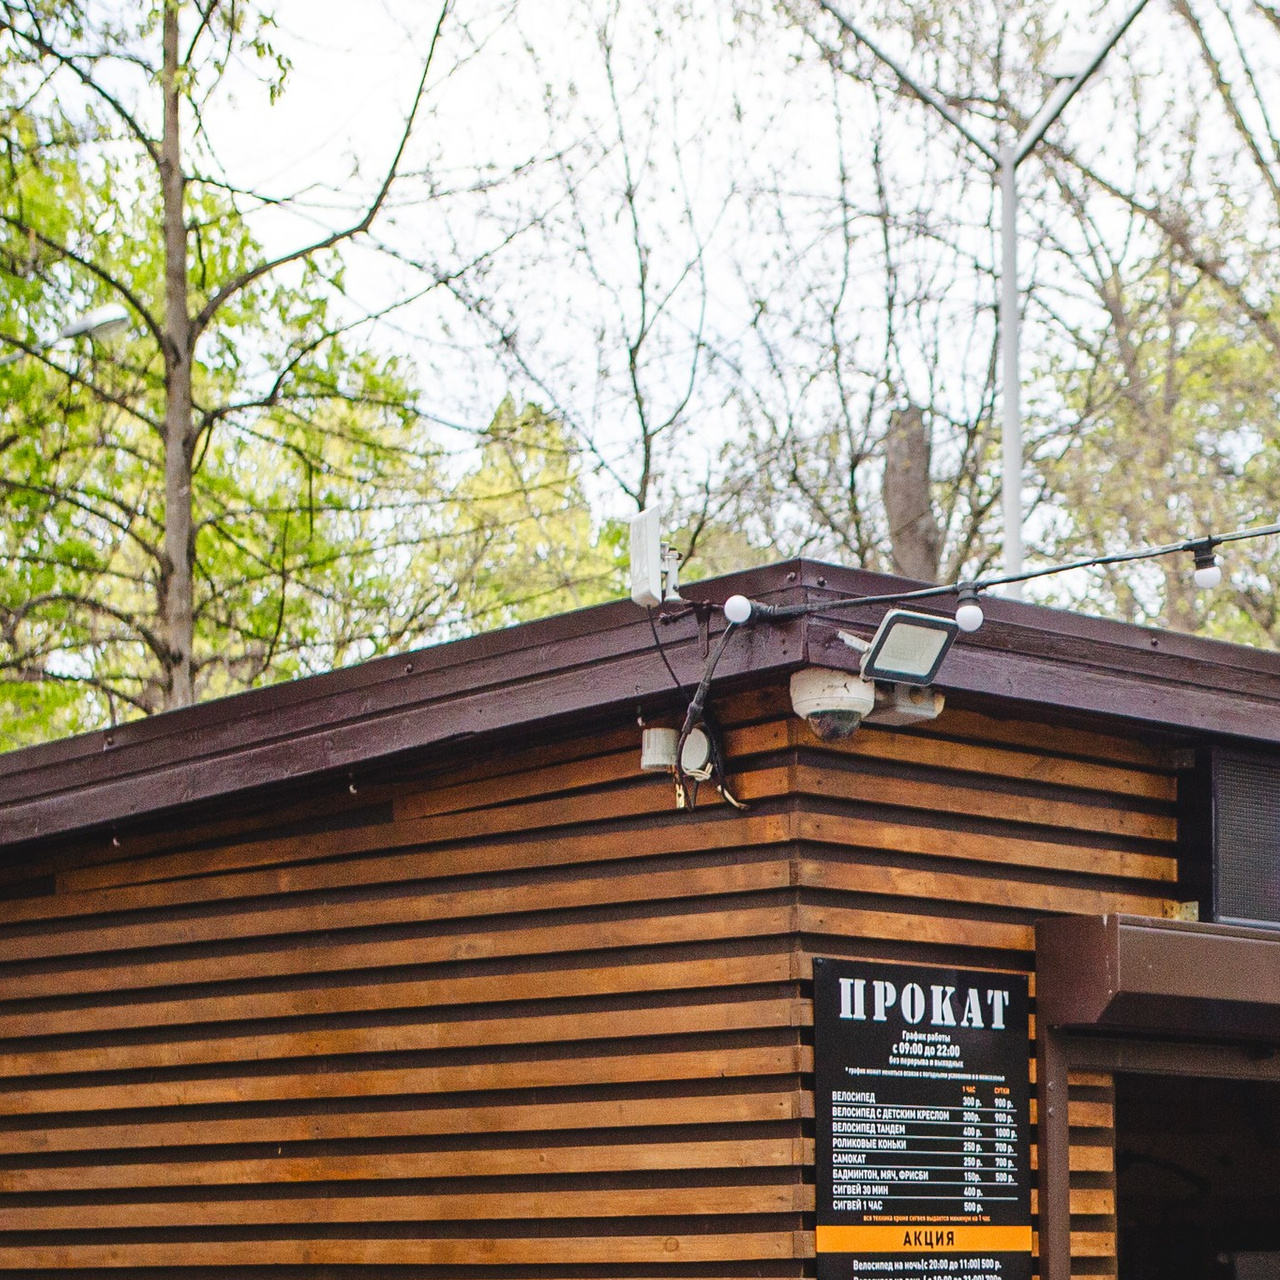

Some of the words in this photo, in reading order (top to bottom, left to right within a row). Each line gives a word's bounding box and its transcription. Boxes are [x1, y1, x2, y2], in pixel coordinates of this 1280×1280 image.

[839, 977, 1009, 1029] ПРОКАТ
[902, 1030, 926, 1042] График
[927, 1032, 951, 1043] работы
[892, 1044, 898, 1054] с
[899, 1042, 923, 1055] 09:00
[924, 1046, 935, 1057] до
[937, 1044, 960, 1058] 22:00
[889, 1055, 900, 1065] без
[900, 1057, 929, 1067] перерыва
[832, 1091, 876, 1104] ВЕЛОСИПЕД
[963, 1096, 975, 1107] 300
[995, 1098, 1006, 1108] 900
[832, 1107, 876, 1119] ВЕЛОСИПЕД
[877, 1108, 882, 1118] С
[883, 1109, 916, 1120] ДЕТСКИМ
[917, 1110, 950, 1121] КРЕСЛОМ
[995, 1113, 1006, 1122] 900
[832, 1122, 876, 1135] ВЕЛОСИПЕД
[877, 1124, 906, 1135] ТАНДЕМ
[963, 1127, 975, 1136] 400
[995, 1128, 1010, 1137] 1000
[833, 1138, 877, 1149] РОЛИКОВЫЕ
[878, 1140, 907, 1150] КОНЬКИ
[963, 1142, 976, 1152] 250
[995, 1143, 1007, 1152] 700
[833, 1154, 866, 1164] САМОКАТ
[964, 1157, 976, 1167] 250
[995, 1158, 1007, 1167] 700
[833, 1169, 880, 1181] БАДМИНТОН,
[880, 1170, 898, 1181] МЯЧ,
[899, 1171, 929, 1181] ФРИСБИ
[995, 1173, 1008, 1182] 500
[833, 1184, 862, 1195] СИГВЕЙ
[863, 1185, 871, 1195] 30
[872, 1186, 889, 1195] МИН
[964, 1187, 976, 1196] 400
[833, 1199, 862, 1210] СИГВЕЙ
[863, 1201, 867, 1210] 1
[868, 1201, 883, 1211] ЧАС
[964, 1202, 976, 1212] 500
[903, 1231, 954, 1249] АКЦИЯ
[853, 1260, 894, 1271] Велосипед
[894, 1262, 903, 1271] на
[929, 1259, 949, 1270] 20:00
[949, 1261, 959, 1271] до
[959, 1258, 981, 1270] 11:00)
[981, 1259, 994, 1269] 500
[995, 1261, 1002, 1271] р.
